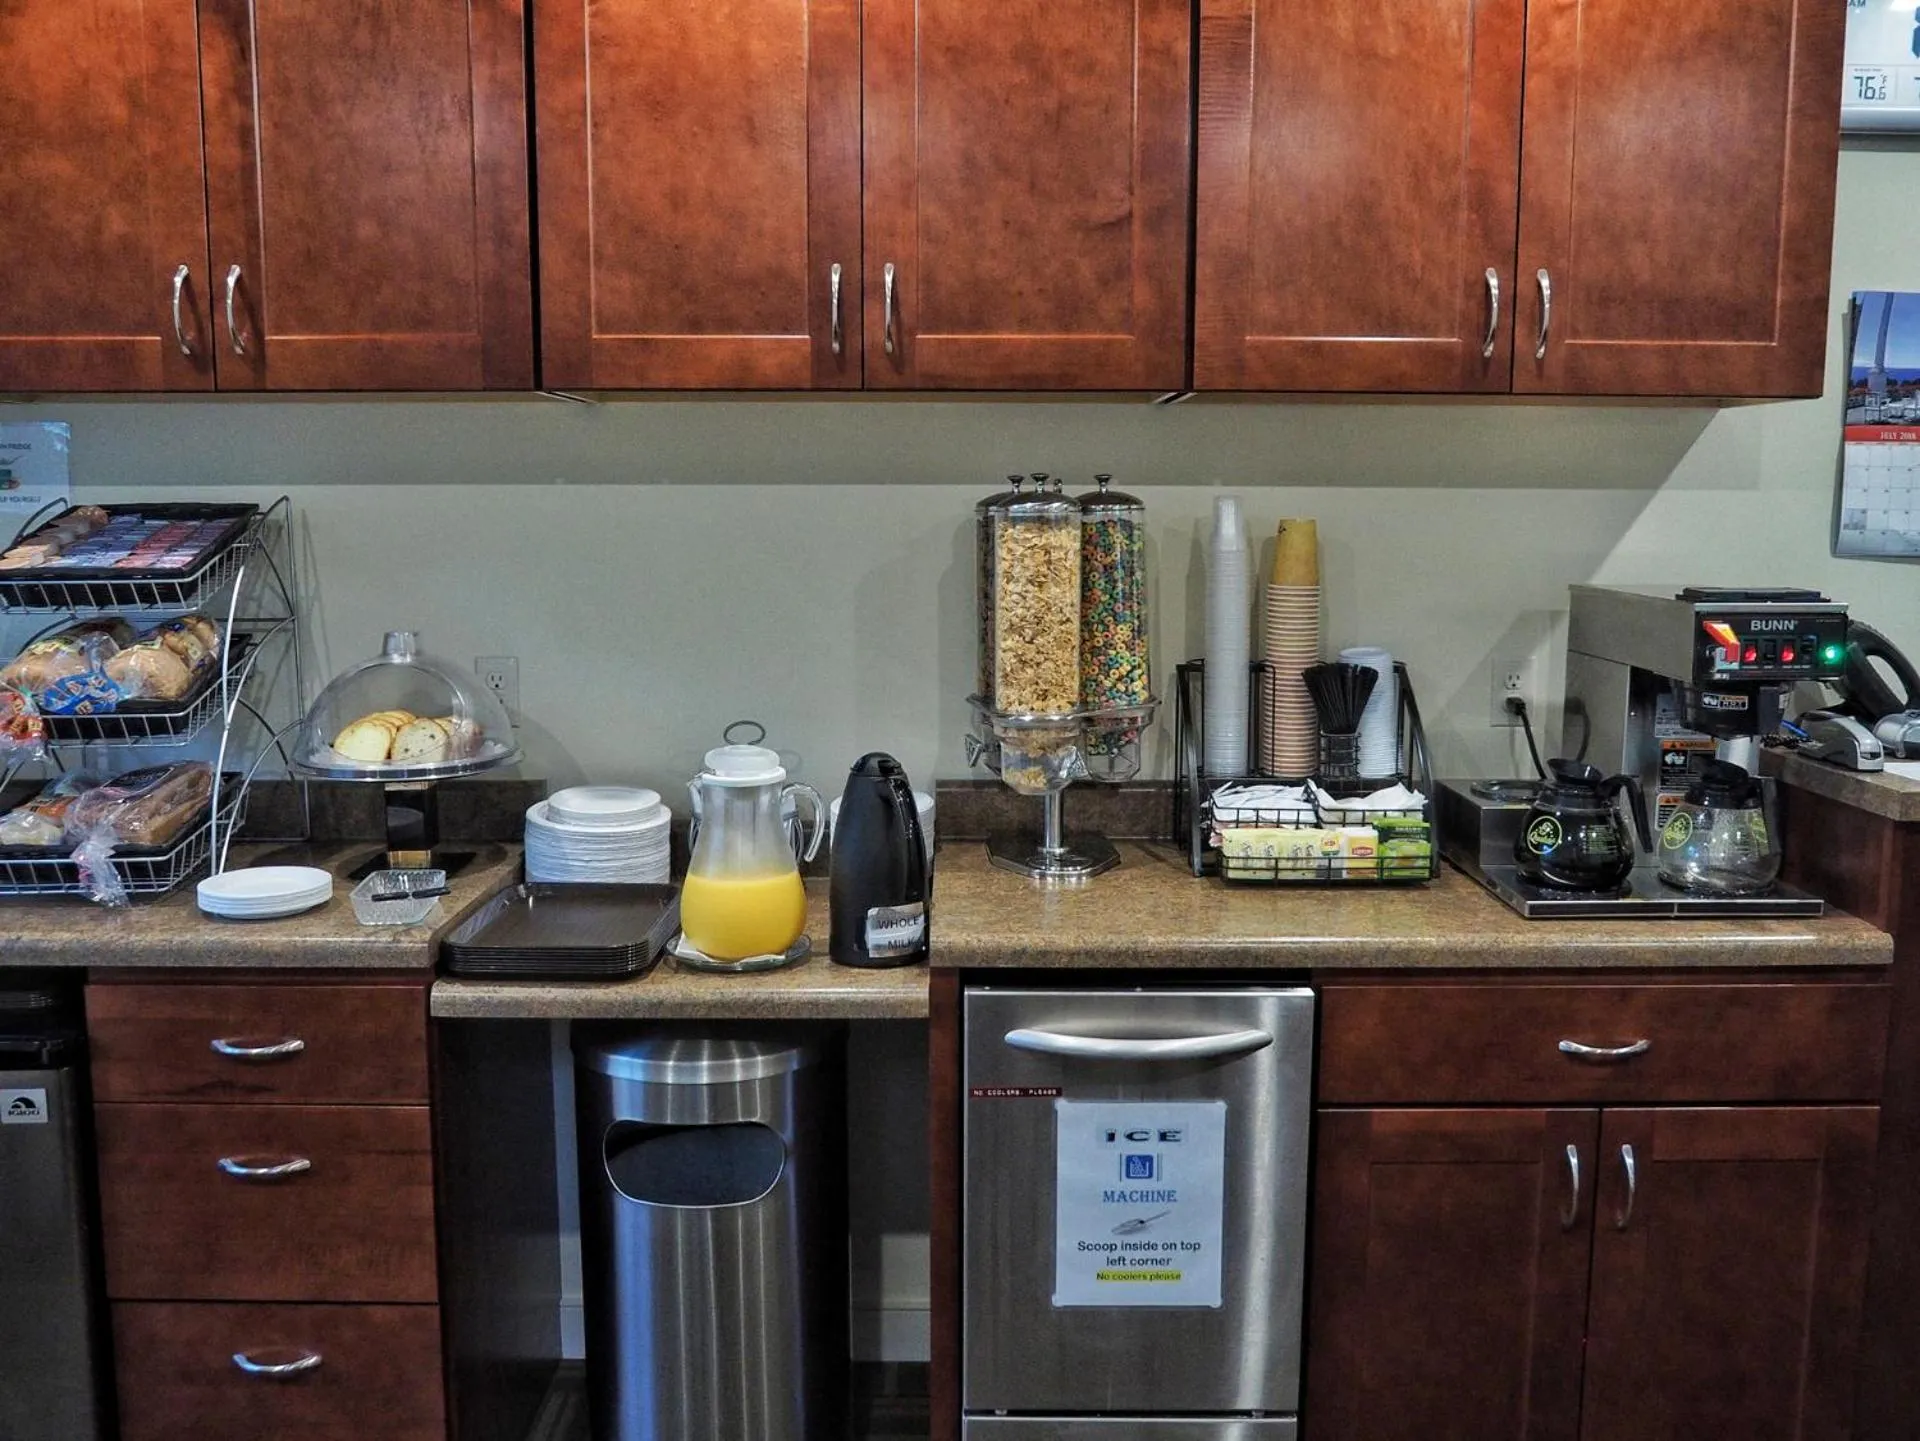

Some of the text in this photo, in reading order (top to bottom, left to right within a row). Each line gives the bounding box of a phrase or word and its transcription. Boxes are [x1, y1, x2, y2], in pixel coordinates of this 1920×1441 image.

[1880, 432, 1897, 440] JULY
[1750, 620, 1795, 631] BUNN
[878, 916, 919, 929] WHOLE
[1106, 1129, 1182, 1142] ICE
[1103, 1190, 1178, 1203] MACHINE
[1077, 1240, 1201, 1253] Scoop inside on top
[1106, 1256, 1173, 1267] left corner
[1096, 1271, 1182, 1283] No coolers please
